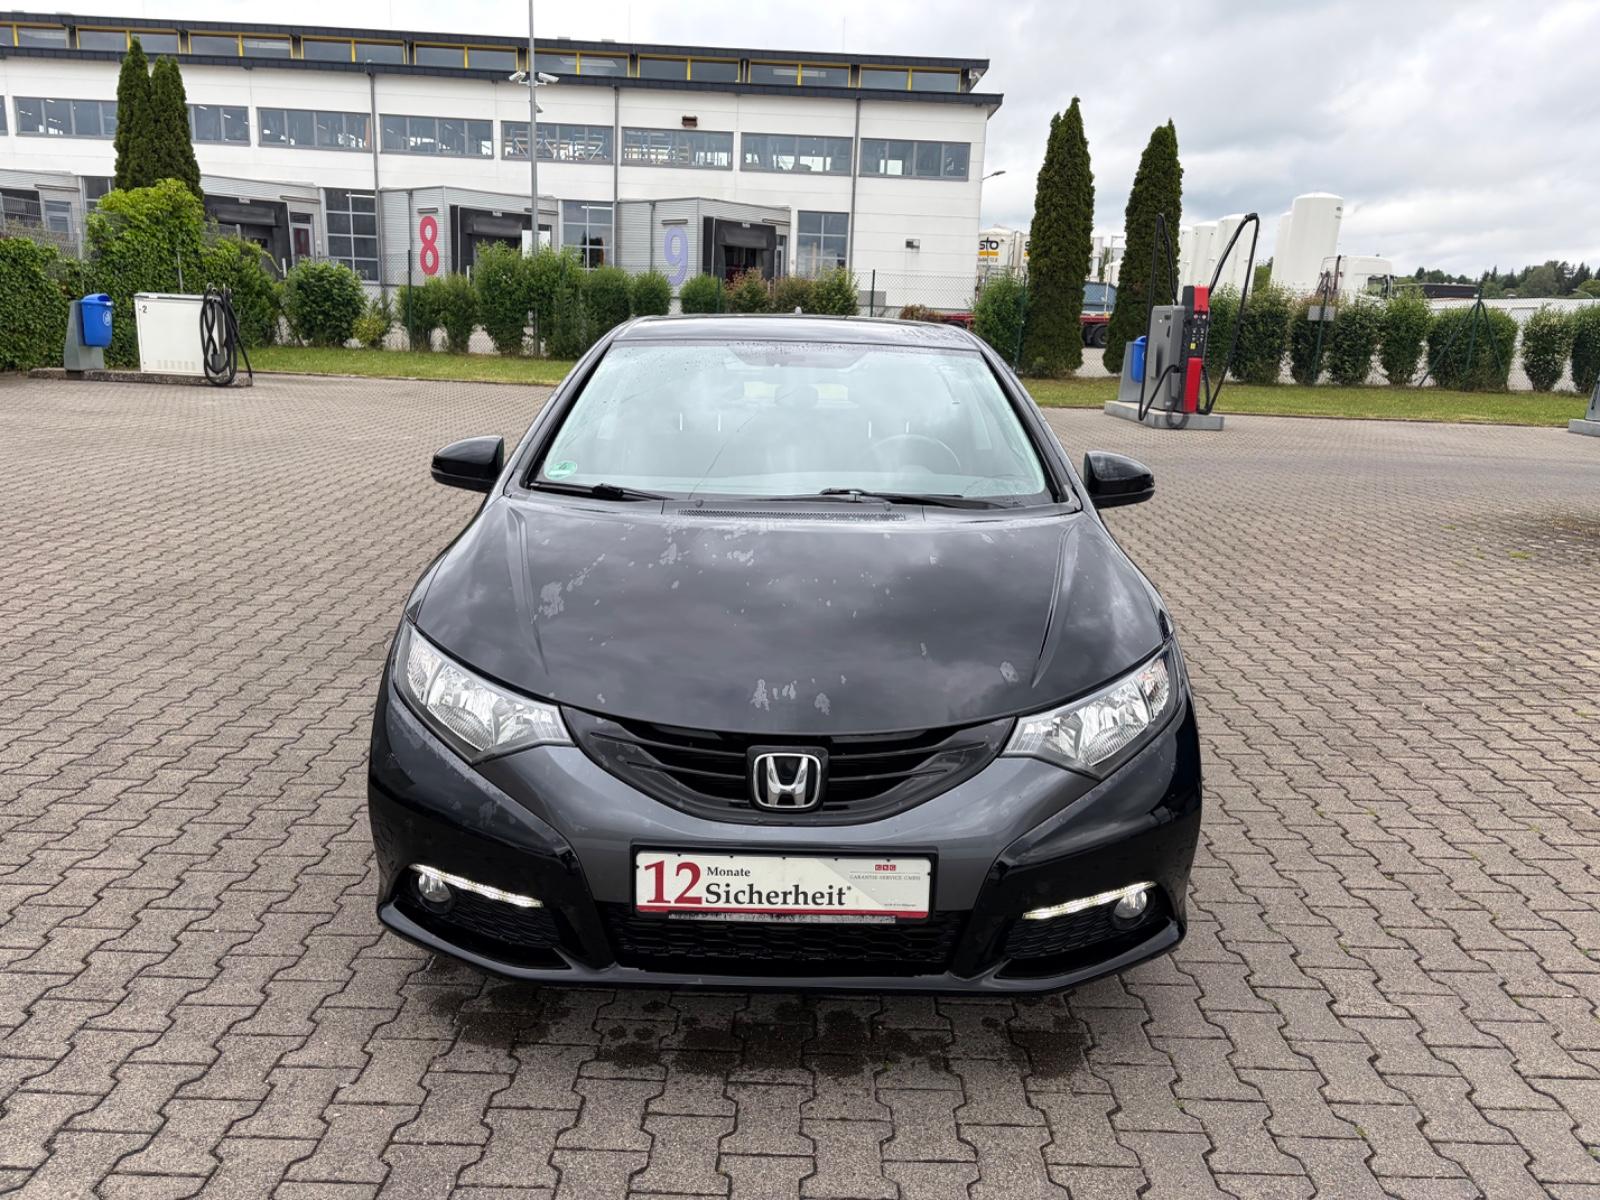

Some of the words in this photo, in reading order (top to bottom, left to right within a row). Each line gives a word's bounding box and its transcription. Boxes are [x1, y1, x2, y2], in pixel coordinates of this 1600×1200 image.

[419, 215, 440, 276] 8
[664, 226, 689, 287] 9
[142, 305, 148, 313] 2
[644, 859, 703, 905] 12
[707, 866, 751, 878] Monate
